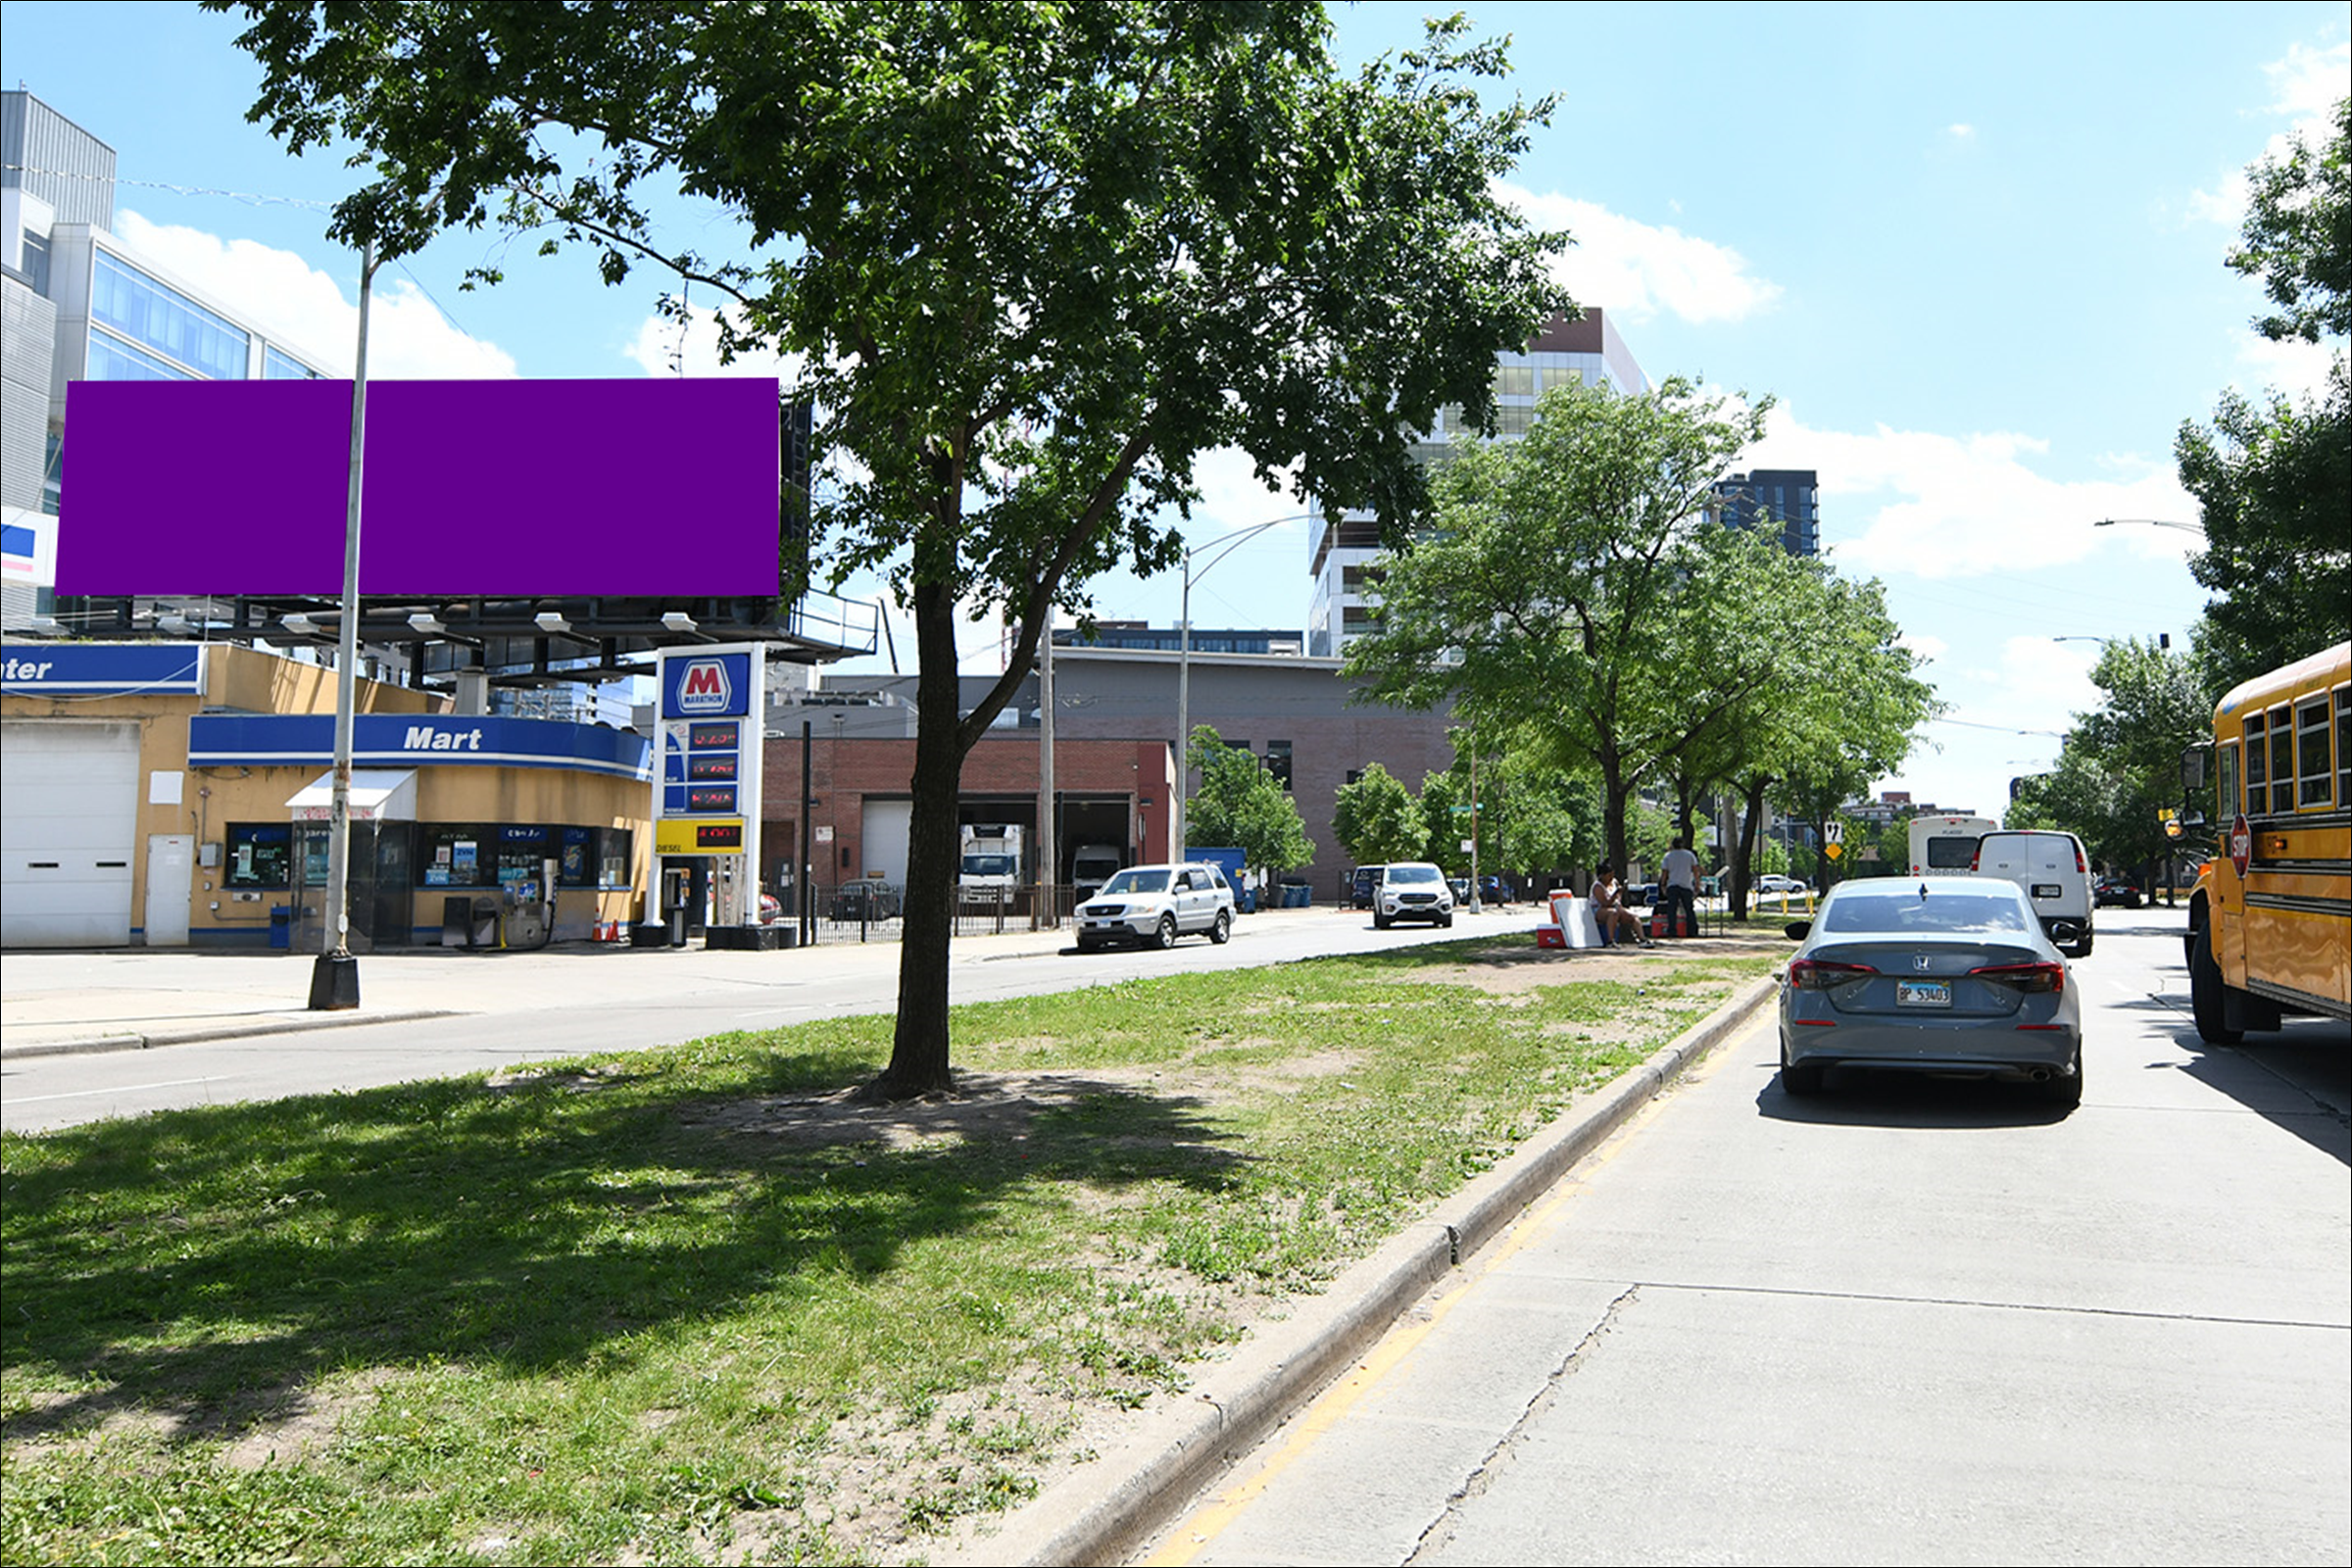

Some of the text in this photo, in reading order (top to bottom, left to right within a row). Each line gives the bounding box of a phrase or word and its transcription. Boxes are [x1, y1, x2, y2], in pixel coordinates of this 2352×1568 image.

[686, 667, 720, 694] M
[685, 694, 722, 704] MARATHON
[403, 726, 482, 750] Mart
[2233, 834, 2248, 857] STOP
